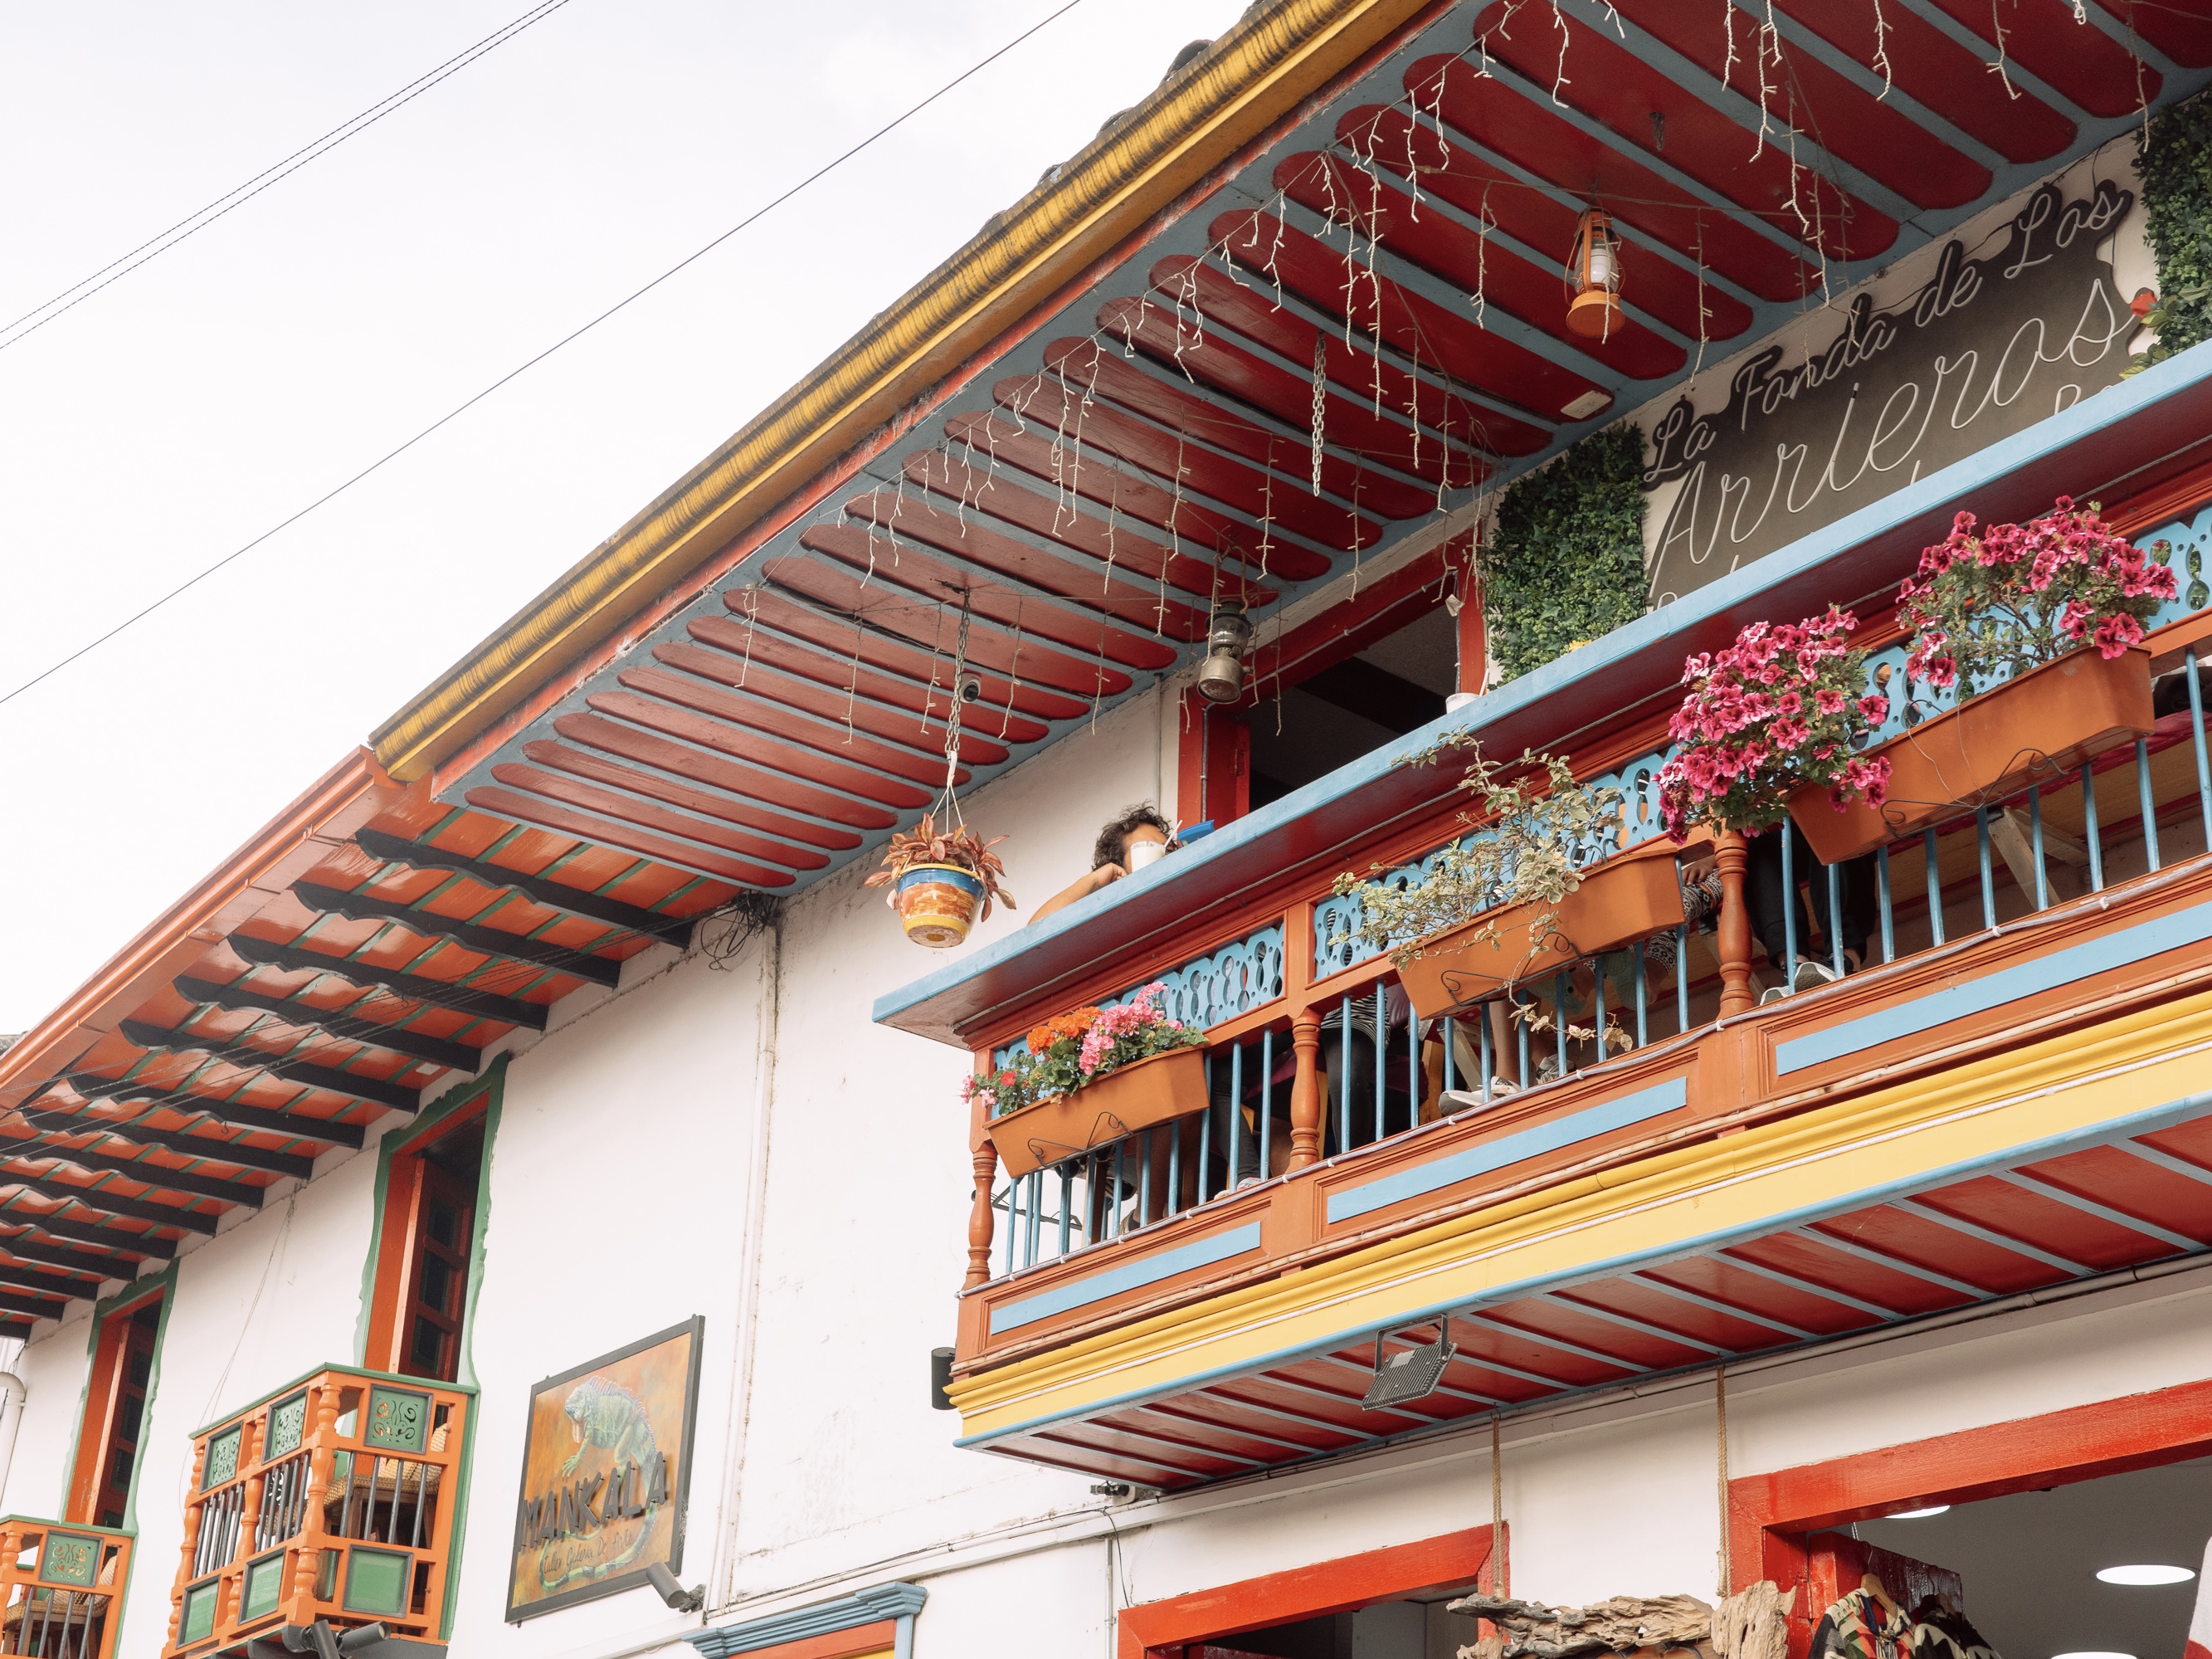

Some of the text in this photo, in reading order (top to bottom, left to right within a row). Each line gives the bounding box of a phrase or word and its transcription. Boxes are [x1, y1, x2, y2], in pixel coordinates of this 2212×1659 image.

[1644, 192, 2125, 482] La Fonda de Los
[1649, 277, 2137, 598] Arrieros
[518, 1451, 665, 1552] MANKALA
[612, 1529, 631, 1551] Arte
